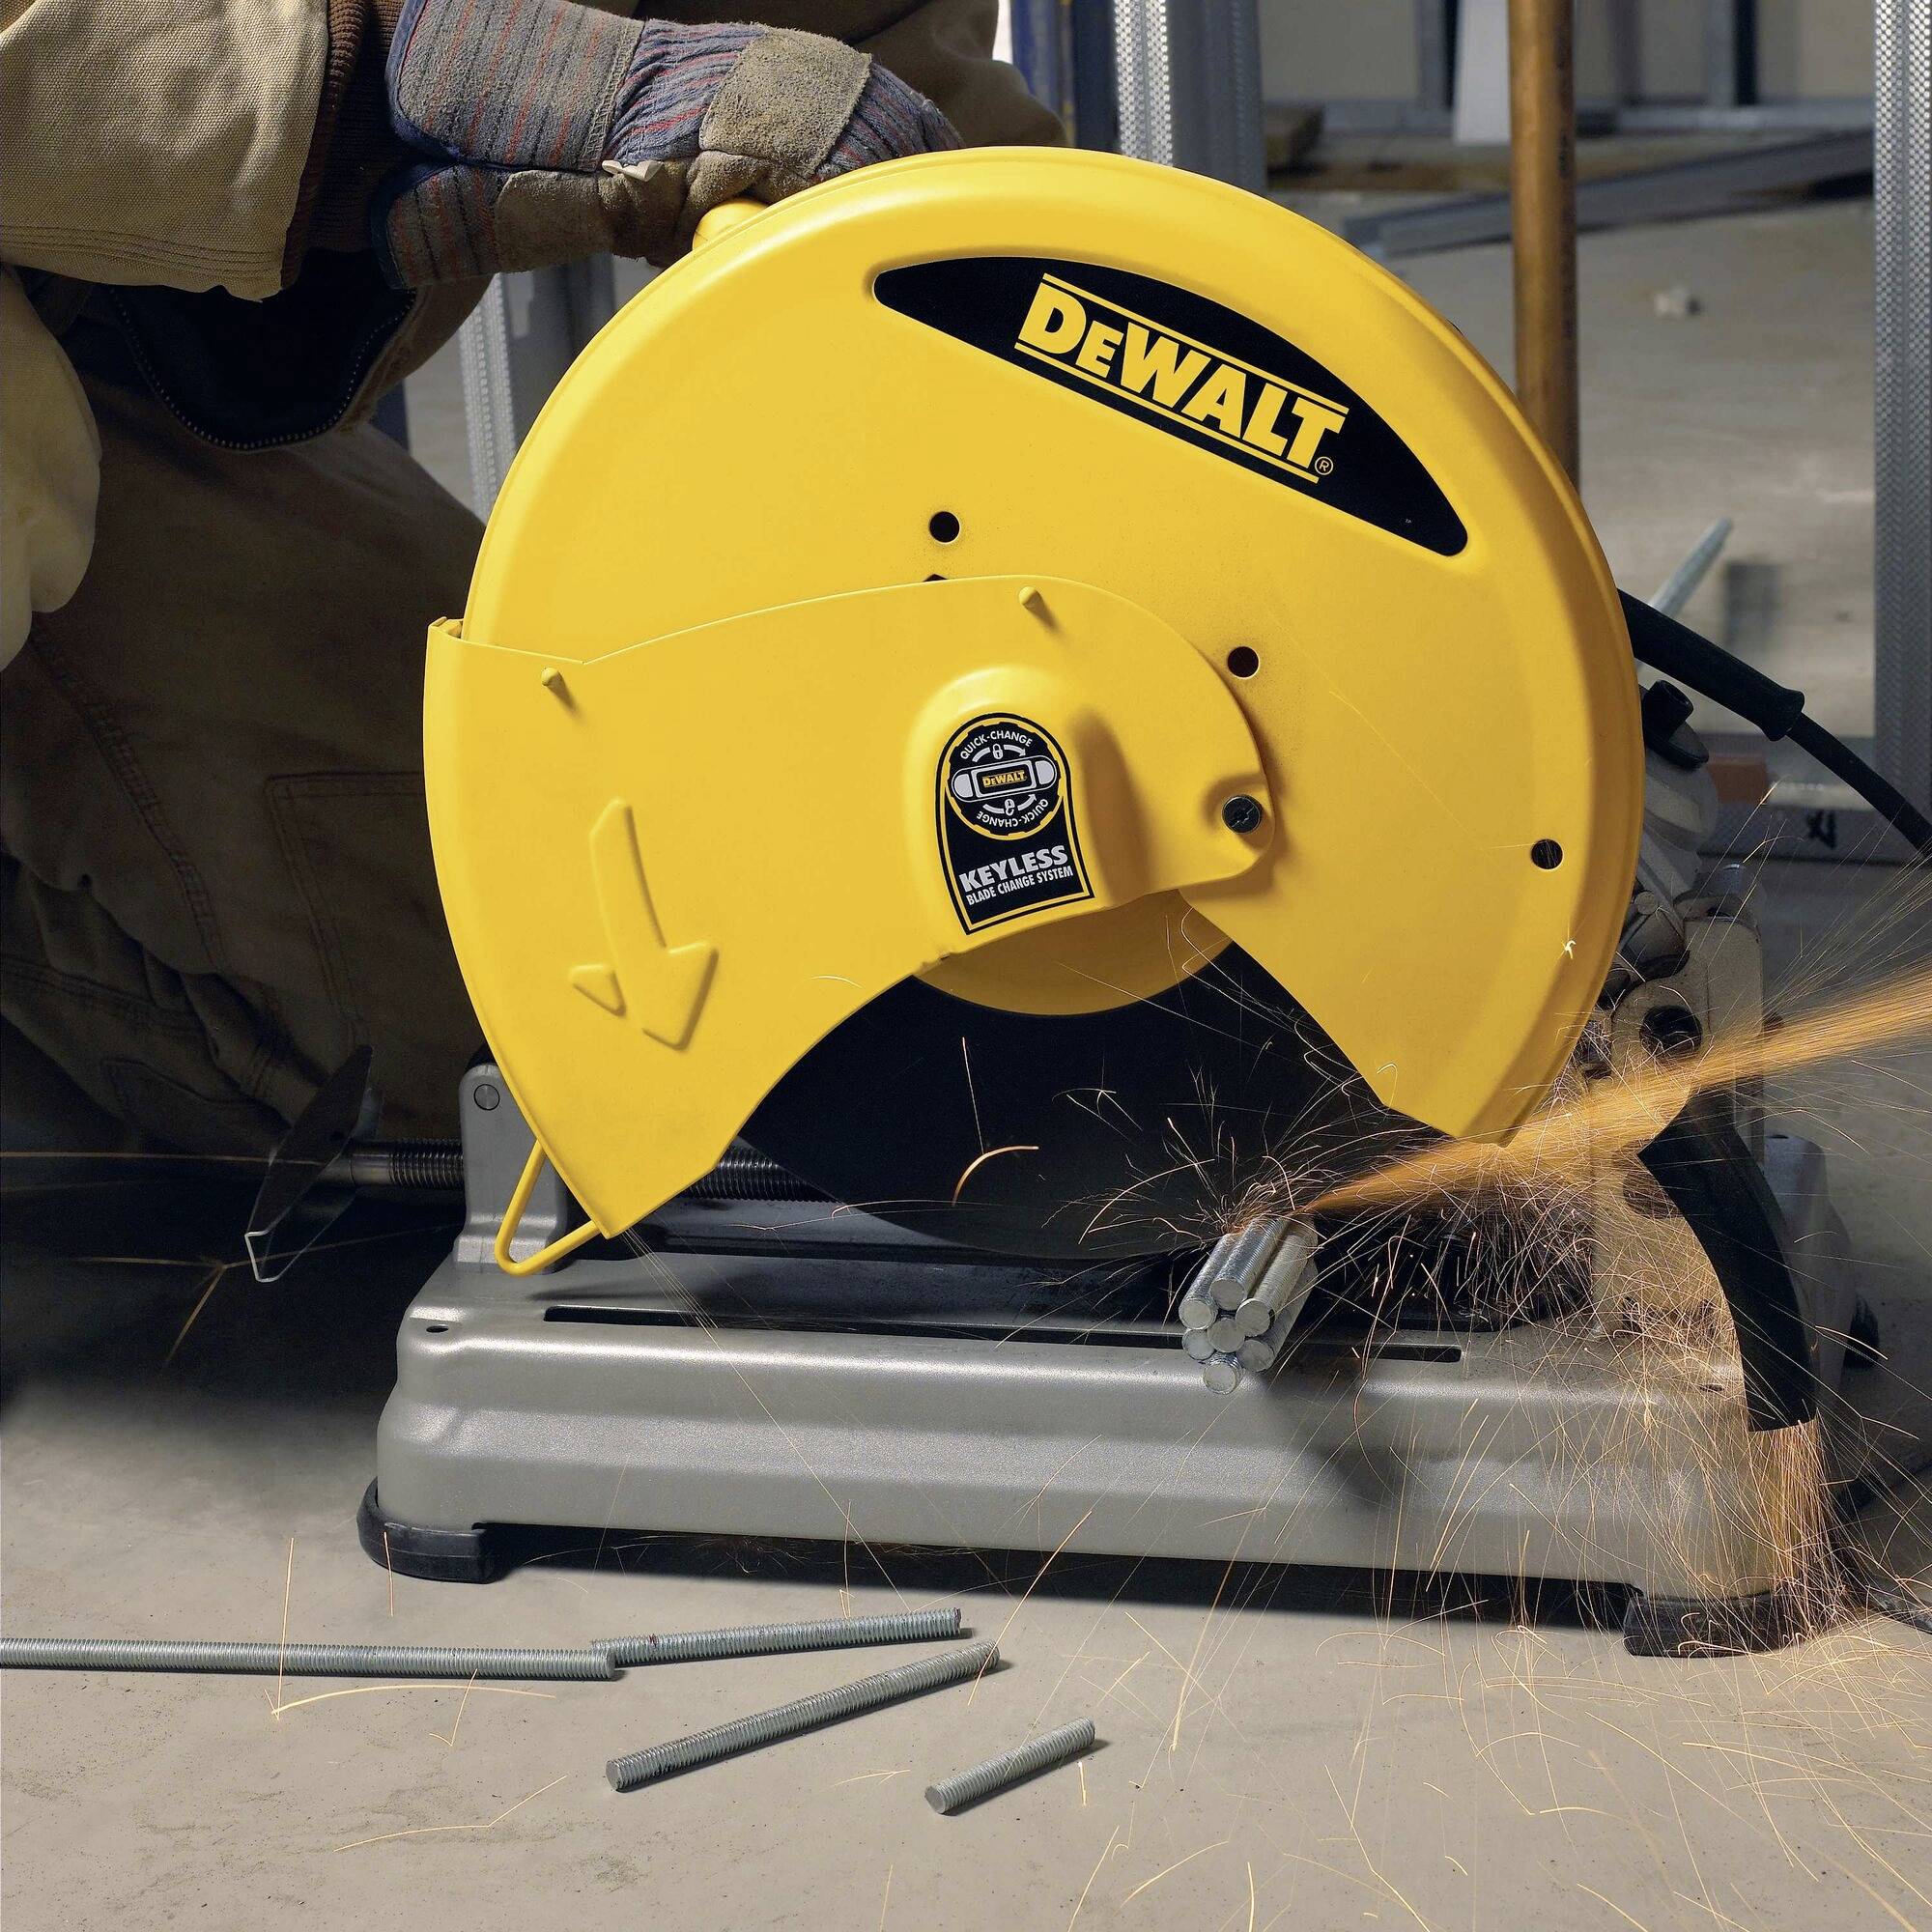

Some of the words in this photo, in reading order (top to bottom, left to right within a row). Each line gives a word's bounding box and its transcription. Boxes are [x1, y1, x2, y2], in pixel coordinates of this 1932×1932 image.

[960, 730, 1033, 760] QUICK-CHANGE
[977, 799, 1049, 828] QUICK-CHANGE
[958, 844, 1068, 892] KEYLESS
[966, 888, 996, 905] BLADE
[999, 876, 1035, 895] CHANGE
[1037, 865, 1073, 883] SYSTEM
